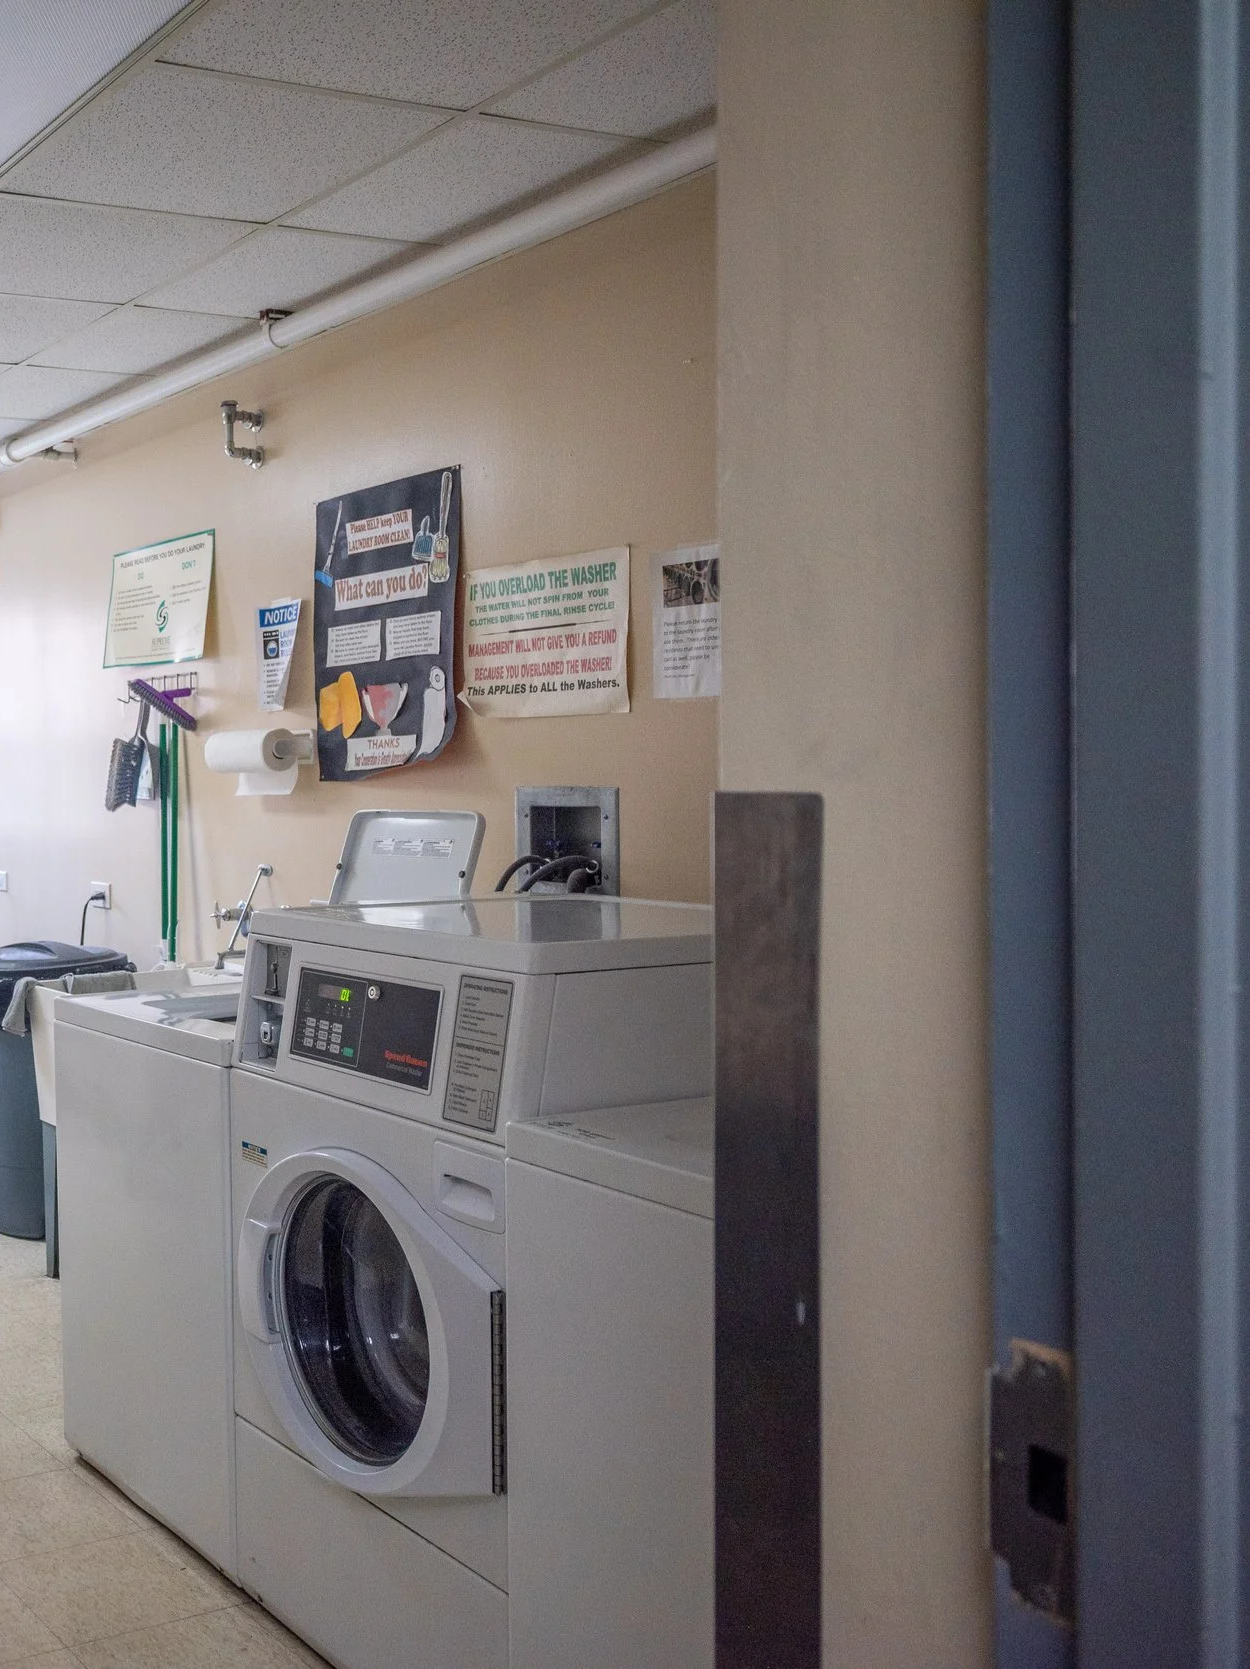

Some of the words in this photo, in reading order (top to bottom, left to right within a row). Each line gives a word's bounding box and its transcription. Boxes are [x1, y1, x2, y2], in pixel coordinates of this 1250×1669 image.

[350, 523, 366, 534] Please
[366, 518, 380, 530] HELP
[380, 517, 392, 528] keep
[393, 511, 409, 524] YOUR
[159, 551, 167, 559] YOU
[168, 550, 174, 558] DO
[175, 547, 186, 555] YOUR
[186, 542, 206, 553] LAUNDRY
[349, 537, 373, 551] LAUNDRY
[374, 534, 390, 547] ROOM
[390, 529, 410, 542] CLEAN!
[336, 579, 363, 602] What
[365, 578, 384, 598] can
[386, 575, 406, 600] you
[409, 565, 427, 590] do?
[470, 584, 478, 601] IF
[480, 581, 496, 599] YOU
[499, 573, 545, 597] OVERLOAD
[548, 569, 568, 589] THE
[571, 562, 617, 586] WASHER
[475, 605, 487, 613] THE
[488, 602, 510, 612] WATER
[511, 600, 526, 609] WILL
[528, 597, 542, 606] NOT
[543, 594, 560, 604] SPIN
[562, 591, 583, 601] FROM
[588, 588, 609, 598] YOUR
[264, 606, 298, 625] NOTICE
[469, 616, 499, 627] CLOTHES
[500, 613, 524, 623] DURING
[526, 611, 539, 620] THE
[541, 608, 561, 618] FINAL
[563, 605, 587, 616] RINSE
[588, 601, 615, 612] CYCLE!
[468, 640, 514, 657] MANAGEMENT
[515, 639, 531, 653] WILL
[531, 637, 545, 652] NOT
[547, 635, 564, 650] GIVE
[565, 632, 580, 648] YOU
[582, 632, 587, 646] A
[588, 629, 617, 646] REFUND
[475, 666, 504, 681] BECAUSE
[506, 665, 519, 679] YOU
[521, 660, 564, 678] OVERLOADED
[566, 659, 579, 674] THE
[581, 656, 613, 673] WASHER!
[467, 686, 486, 696] This
[487, 683, 526, 696] APPLIES
[529, 684, 538, 693] to
[540, 681, 558, 693] ALL
[560, 681, 575, 691] the
[578, 678, 620, 690] Washers.
[367, 738, 400, 749] THANKS
